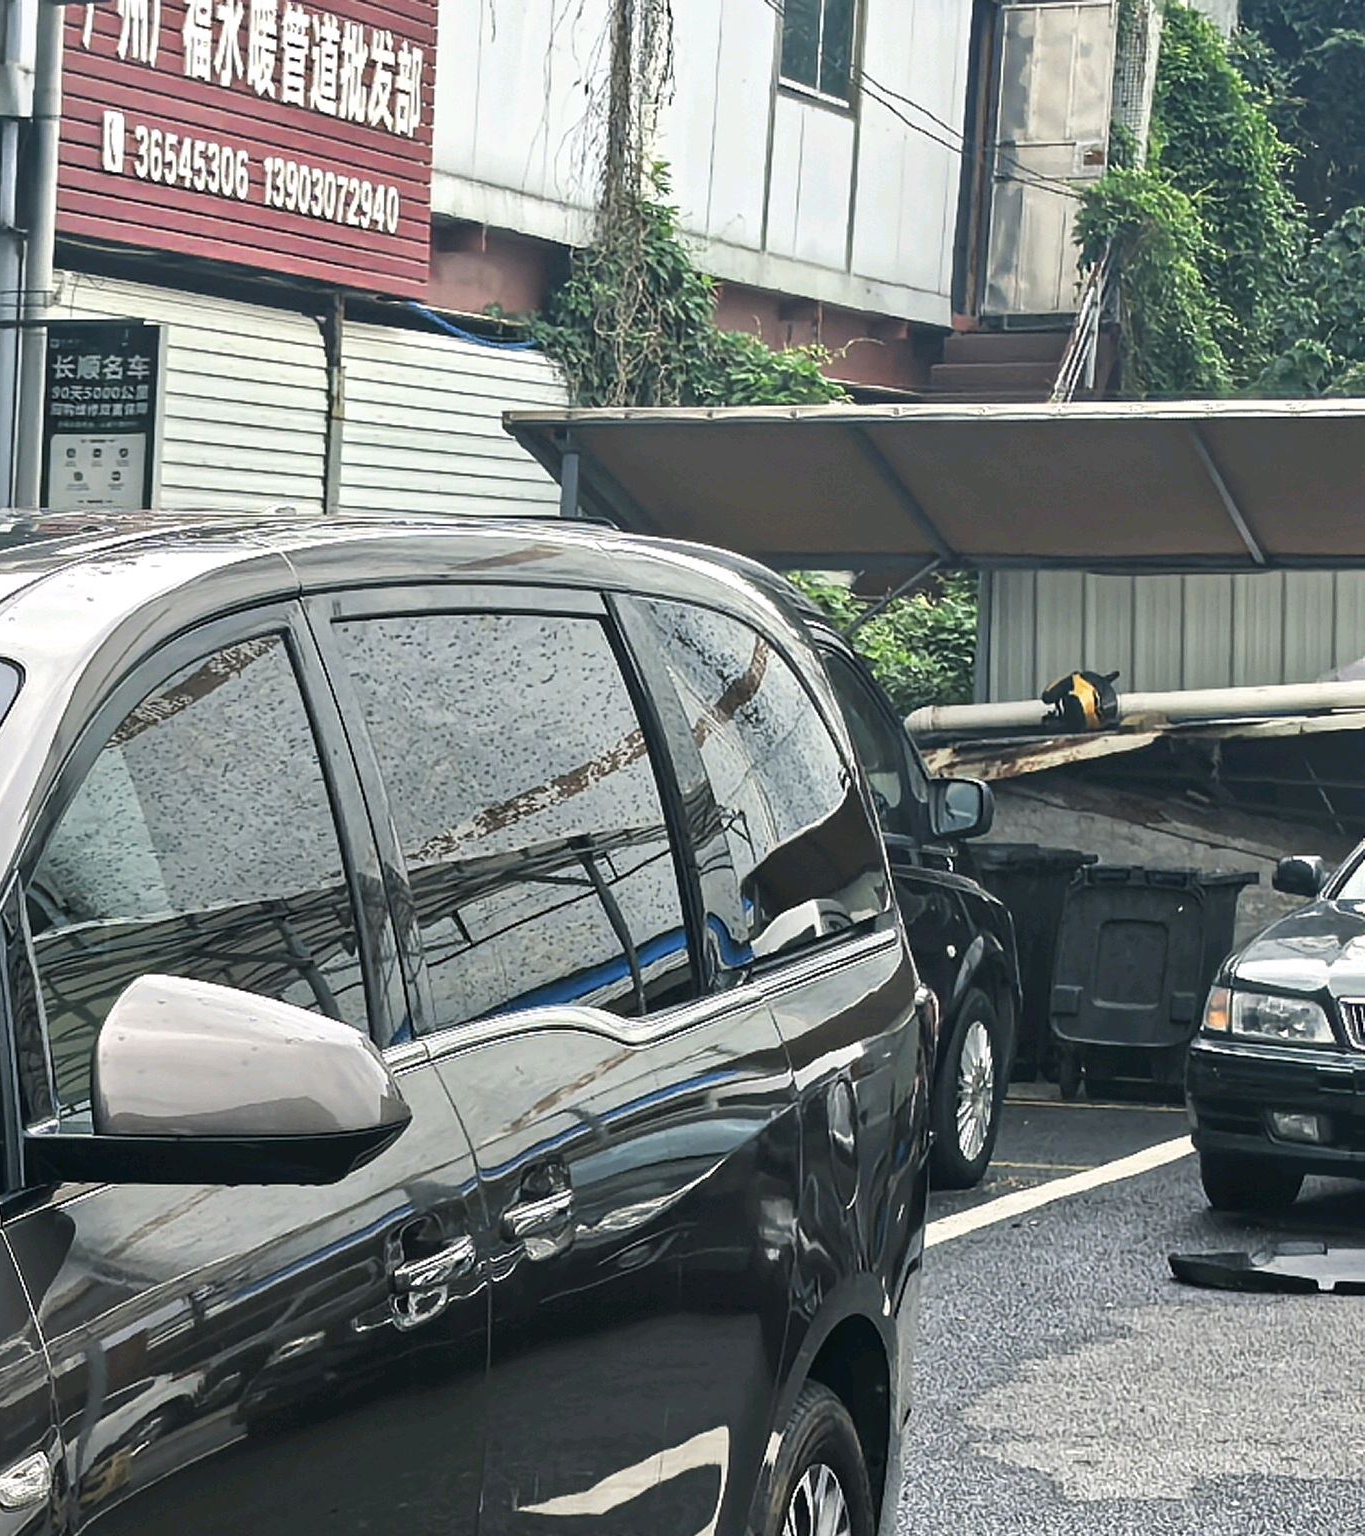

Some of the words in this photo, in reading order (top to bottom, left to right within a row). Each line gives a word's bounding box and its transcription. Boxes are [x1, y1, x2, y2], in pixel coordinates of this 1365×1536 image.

[134, 125, 249, 201] 36545306
[263, 160, 400, 234] 13903072940
[51, 354, 150, 380] 长顺名车
[51, 384, 149, 401] 90天5000公里
